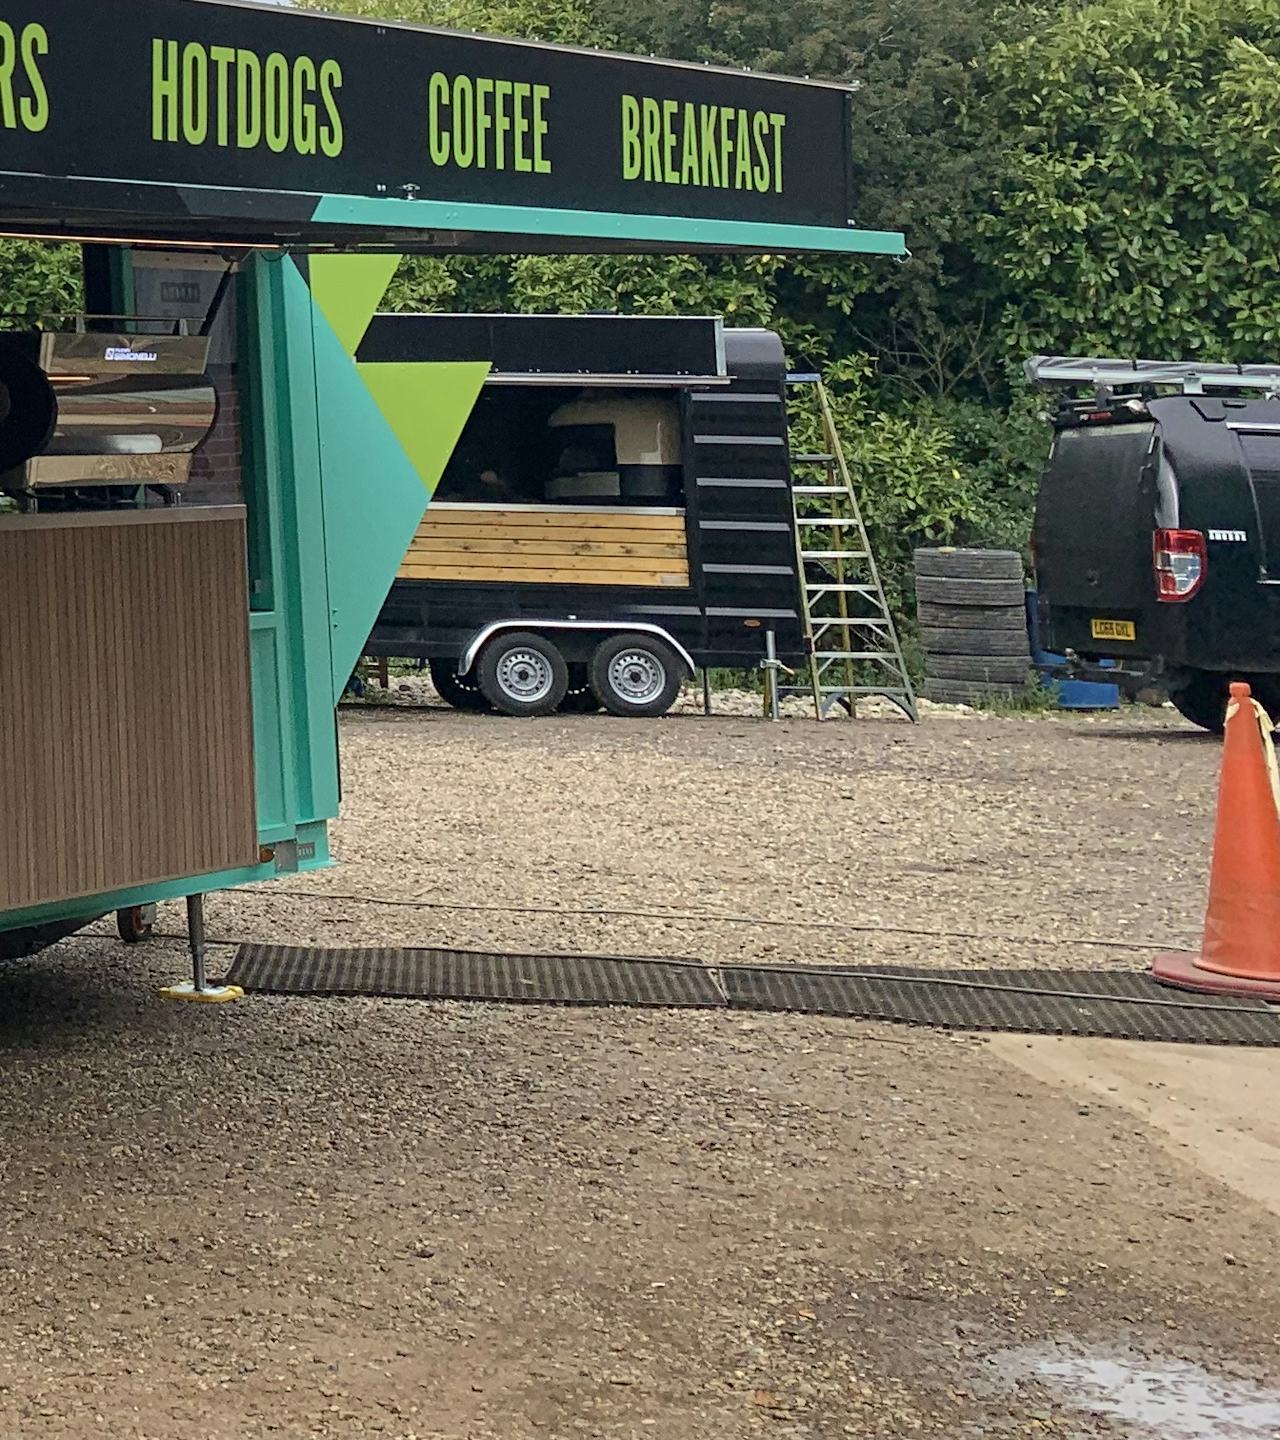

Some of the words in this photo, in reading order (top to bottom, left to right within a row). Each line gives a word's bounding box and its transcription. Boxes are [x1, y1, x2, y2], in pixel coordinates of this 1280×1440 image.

[151, 37, 343, 158] HOTDOGS
[428, 71, 552, 174] COFFEE
[621, 94, 786, 193] BREAKFAST
